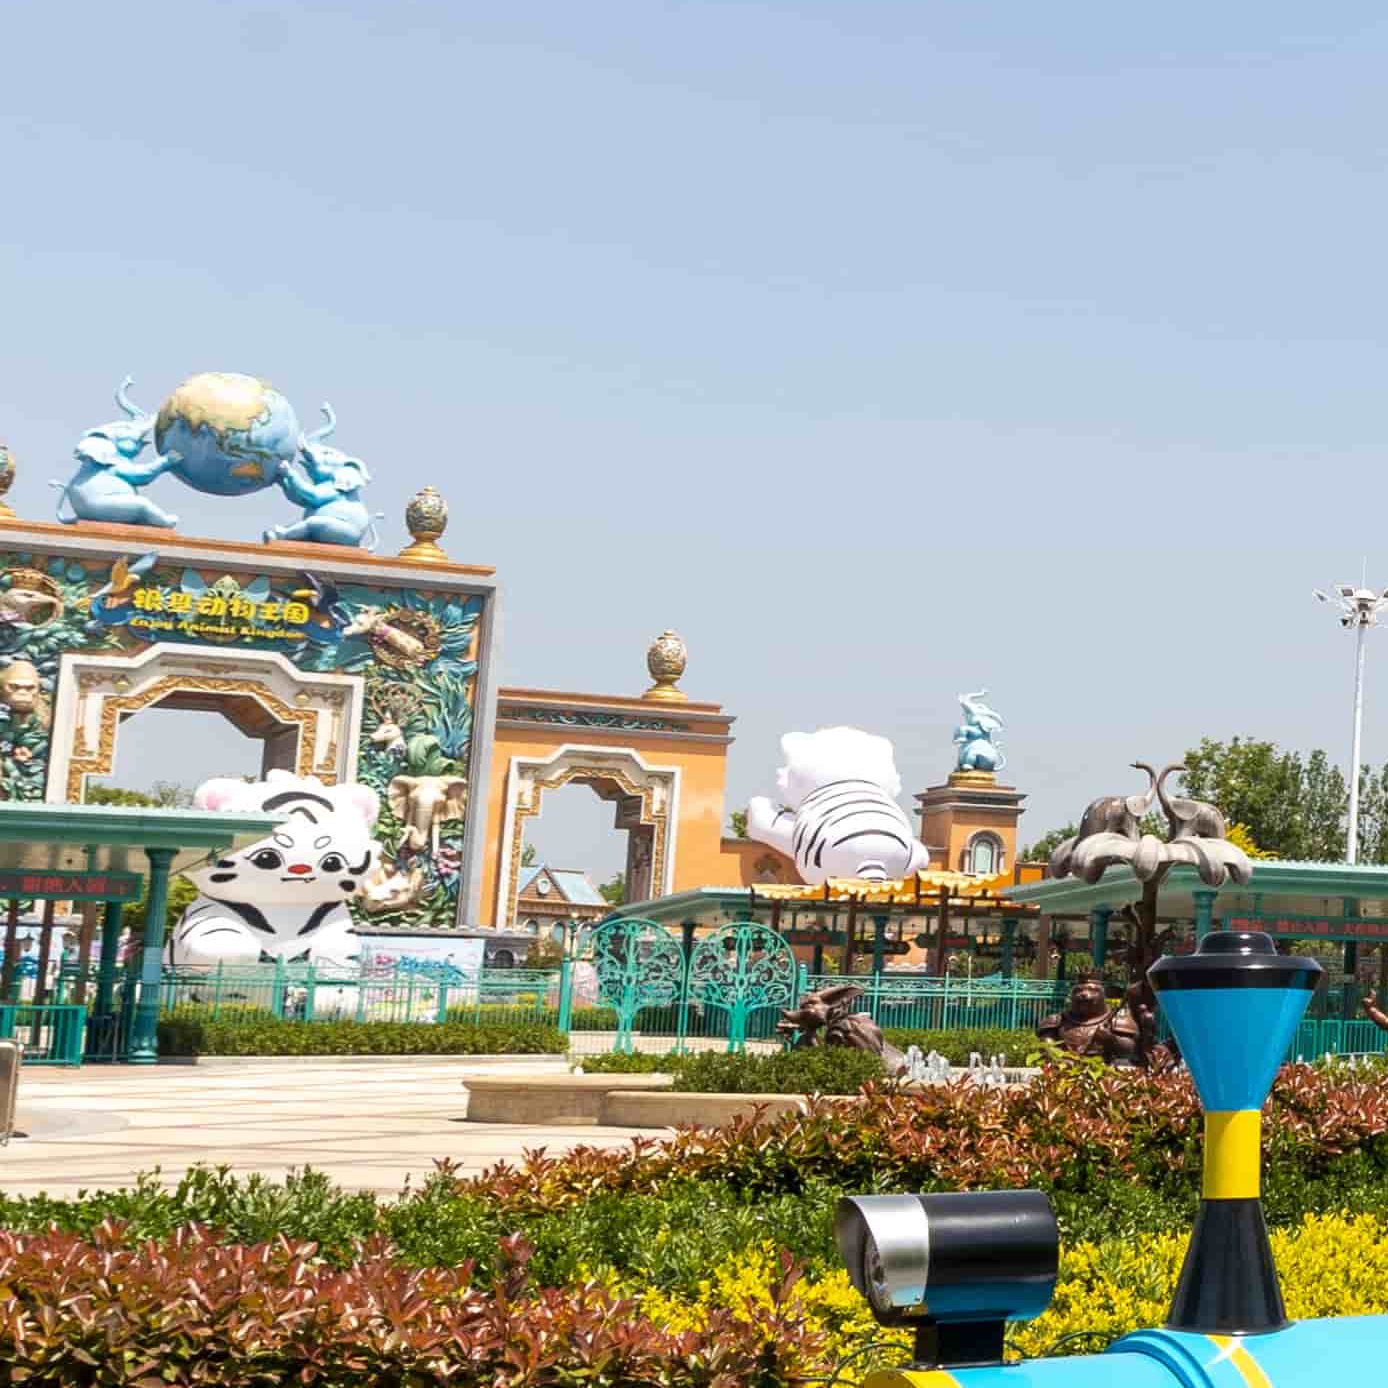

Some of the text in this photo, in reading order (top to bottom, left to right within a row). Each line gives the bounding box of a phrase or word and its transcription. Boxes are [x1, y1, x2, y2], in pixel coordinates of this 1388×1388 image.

[133, 587, 309, 624] 银基动物王国
[176, 619, 236, 634] Animal
